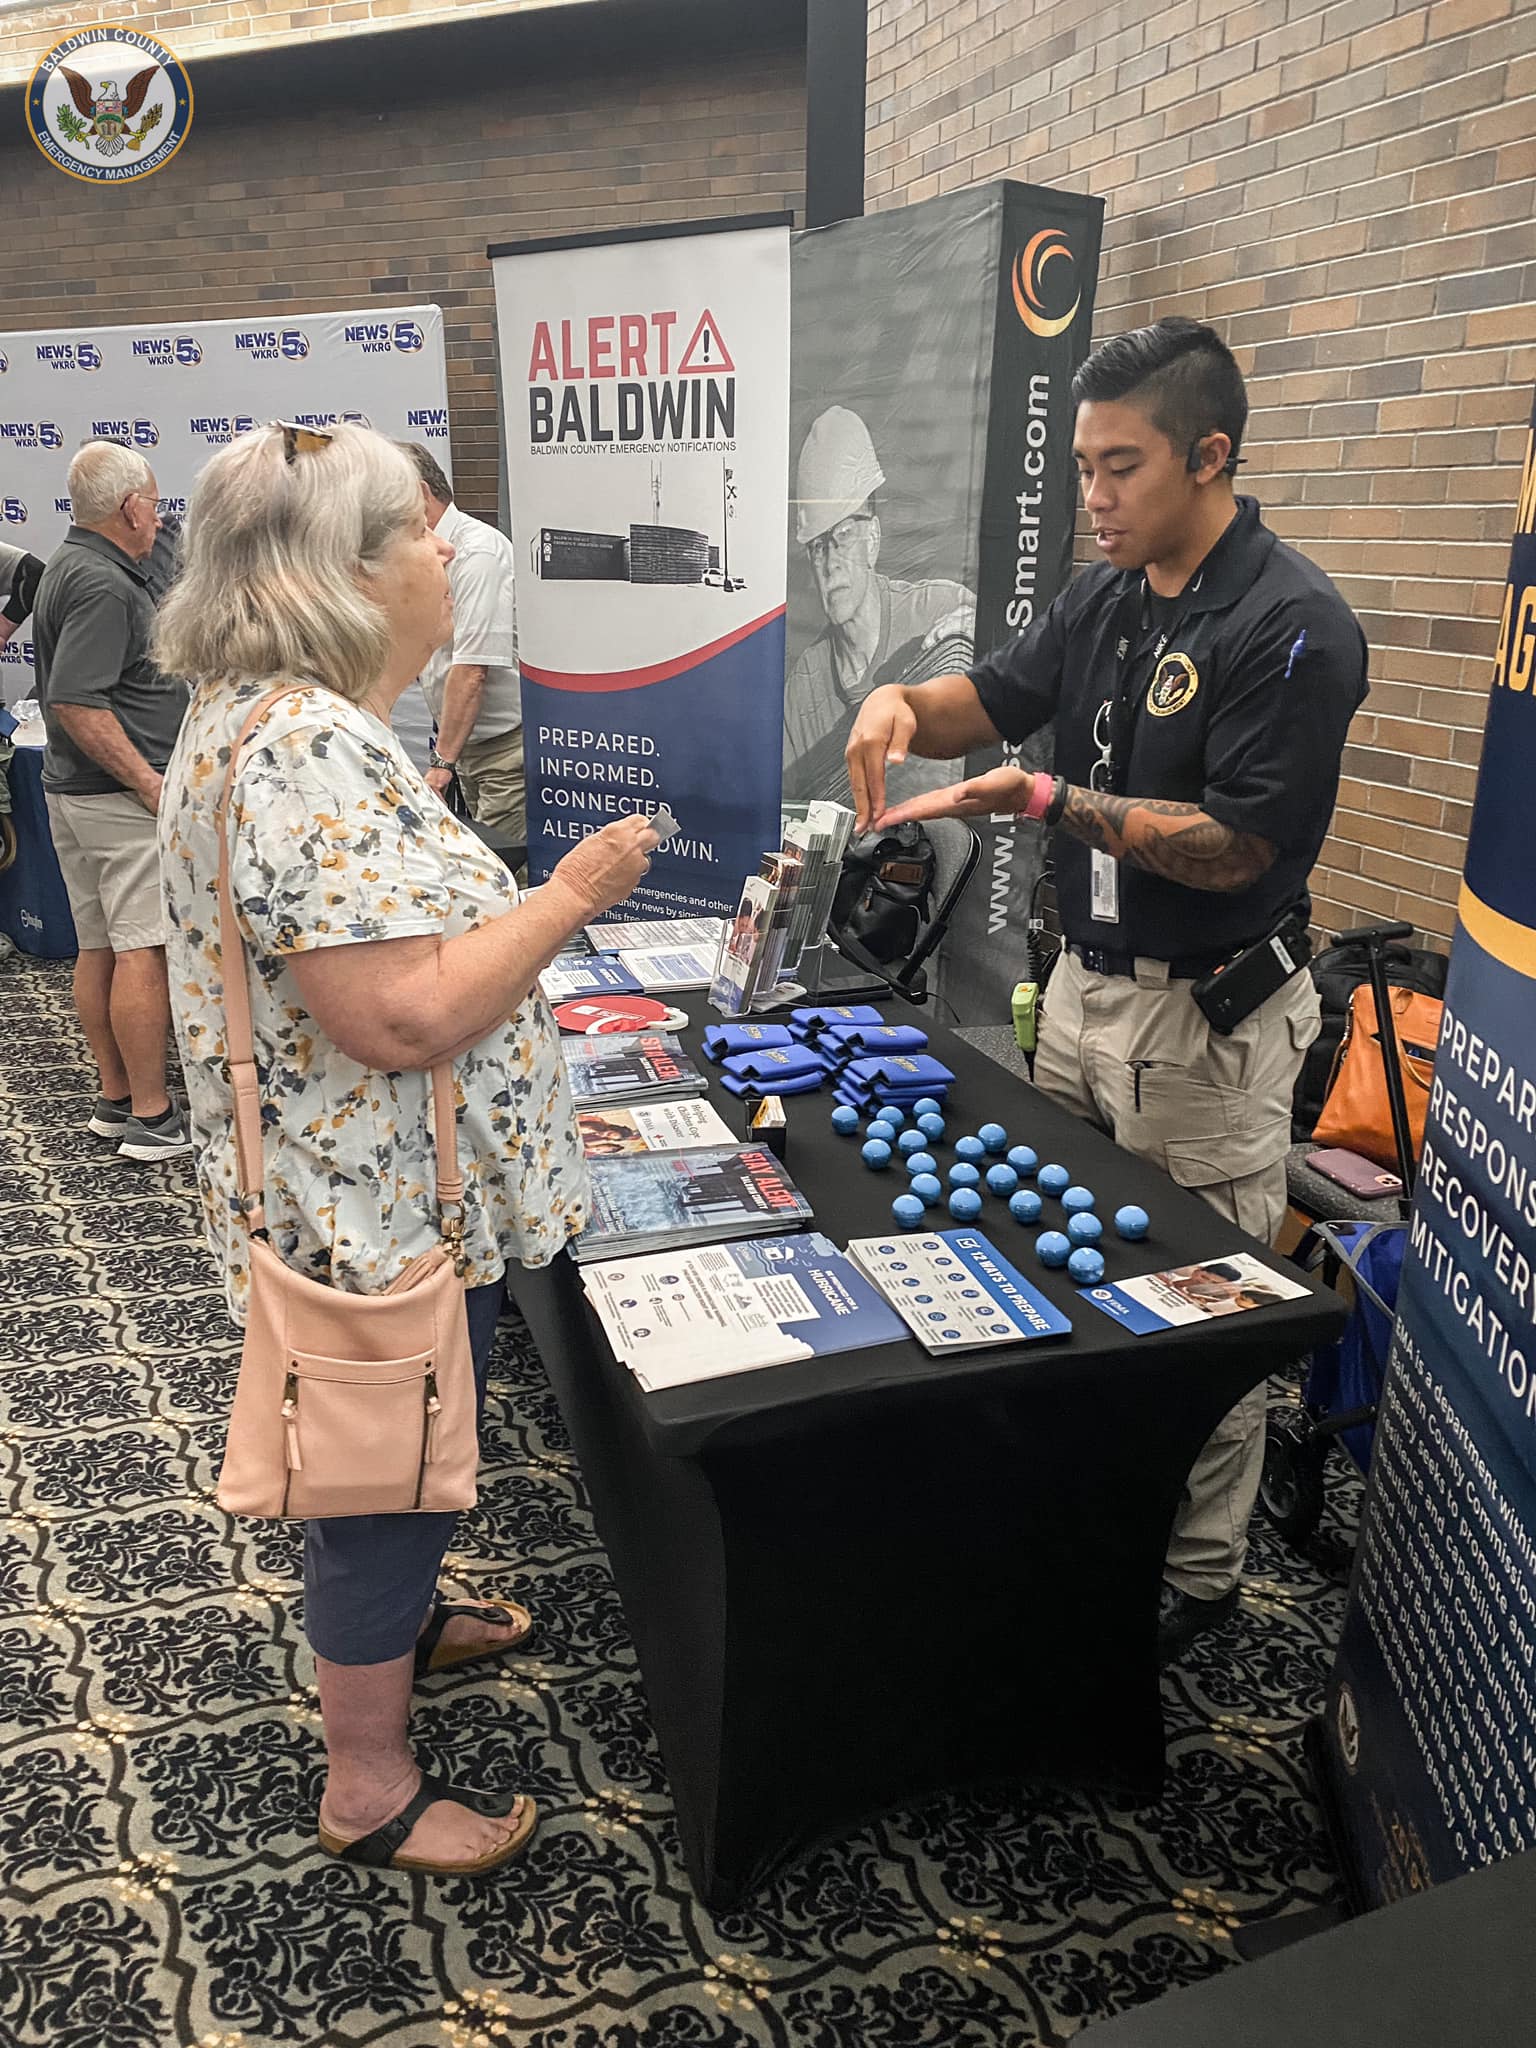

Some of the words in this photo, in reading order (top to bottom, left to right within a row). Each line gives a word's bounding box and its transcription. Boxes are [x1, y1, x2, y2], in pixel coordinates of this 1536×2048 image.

[235, 332, 277, 348] NEWS
[345, 324, 389, 342] NEWS
[36, 345, 73, 360] NEWS
[132, 340, 171, 355] NEWS
[251, 349, 279, 360] WKRG
[362, 342, 391, 353] WKRG
[528, 311, 677, 381] ALERT
[51, 360, 76, 370] WKRG
[148, 356, 174, 366] WKRG
[529, 377, 736, 443] BALDWIN
[0, 424, 35, 437] NEWS
[92, 421, 130, 436] NEWS
[190, 418, 230, 434] NEWS
[14, 438, 39, 448] WKRG
[206, 435, 233, 444] WKRG
[530, 444, 568, 455] BALDWIN
[570, 443, 607, 455] COUNTY
[609, 442, 666, 454] EMERGENCY
[667, 440, 737, 453] NOTIFICATIONS
[55, 498, 72, 512] NE
[539, 726, 660, 757] PREPARED.
[540, 756, 660, 788] INFORMED.
[604, 909, 622, 920] This
[642, 903, 664, 914] news
[665, 905, 677, 918] by
[688, 896, 706, 907] and
[707, 899, 733, 912] other
[738, 1152, 776, 1176] STAY
[755, 1177, 798, 1208] ALERT
[807, 1269, 851, 1316] HURRICANE
[970, 1251, 982, 1263] 12
[977, 1259, 1002, 1287] WAYS
[999, 1282, 1016, 1296] TO
[1010, 1293, 1051, 1331] PREPARE
[1392, 1346, 1427, 1420] Baldwin
[1428, 1414, 1465, 1487] County
[1395, 1316, 1413, 1360] EMA
[1414, 1350, 1425, 1376] is
[1425, 1371, 1433, 1389] a
[1433, 1383, 1498, 1501] department
[1382, 1411, 1425, 1496] resilience
[1425, 1494, 1446, 1536] and
[1446, 1534, 1500, 1647] capability
[1386, 1381, 1417, 1445] agency
[1417, 1438, 1446, 1494] seeks
[1447, 1487, 1459, 1518] to
[1459, 1517, 1508, 1615] promote
[1508, 1613, 1535, 1668] and
[1379, 1437, 1418, 1523] beautiful
[1418, 1520, 1454, 1597] coastal
[1454, 1595, 1519, 1743] community.
[1374, 1467, 1395, 1520] hand
[1395, 1512, 1406, 1542] in
[1406, 1539, 1432, 1594] hand
[1433, 1591, 1456, 1648] with
[1456, 1646, 1476, 1689] our
[1475, 1688, 1526, 1806] partners
[1370, 1500, 1402, 1573] citizens
[1403, 1571, 1415, 1596] of
[1413, 1591, 1454, 1687] Baldwin
[1455, 1684, 1494, 1779] County
[1494, 1776, 1508, 1814] to
[1365, 1527, 1385, 1572] that
[1384, 1566, 1400, 1606] the
[1400, 1605, 1427, 1665] place
[1426, 1662, 1442, 1703] we
[1442, 1697, 1461, 1748] live
[1461, 1750, 1484, 1804] and
[1484, 1804, 1512, 1860] wor
[1358, 1584, 1402, 1697] unforeseen
[1402, 1696, 1456, 1829] emergency
[1455, 1831, 1469, 1861] or
[1378, 1596, 1418, 1690] prepared
[1418, 1685, 1430, 1718] in
[1430, 1714, 1448, 1761] the
[1448, 1764, 1477, 1840] event
